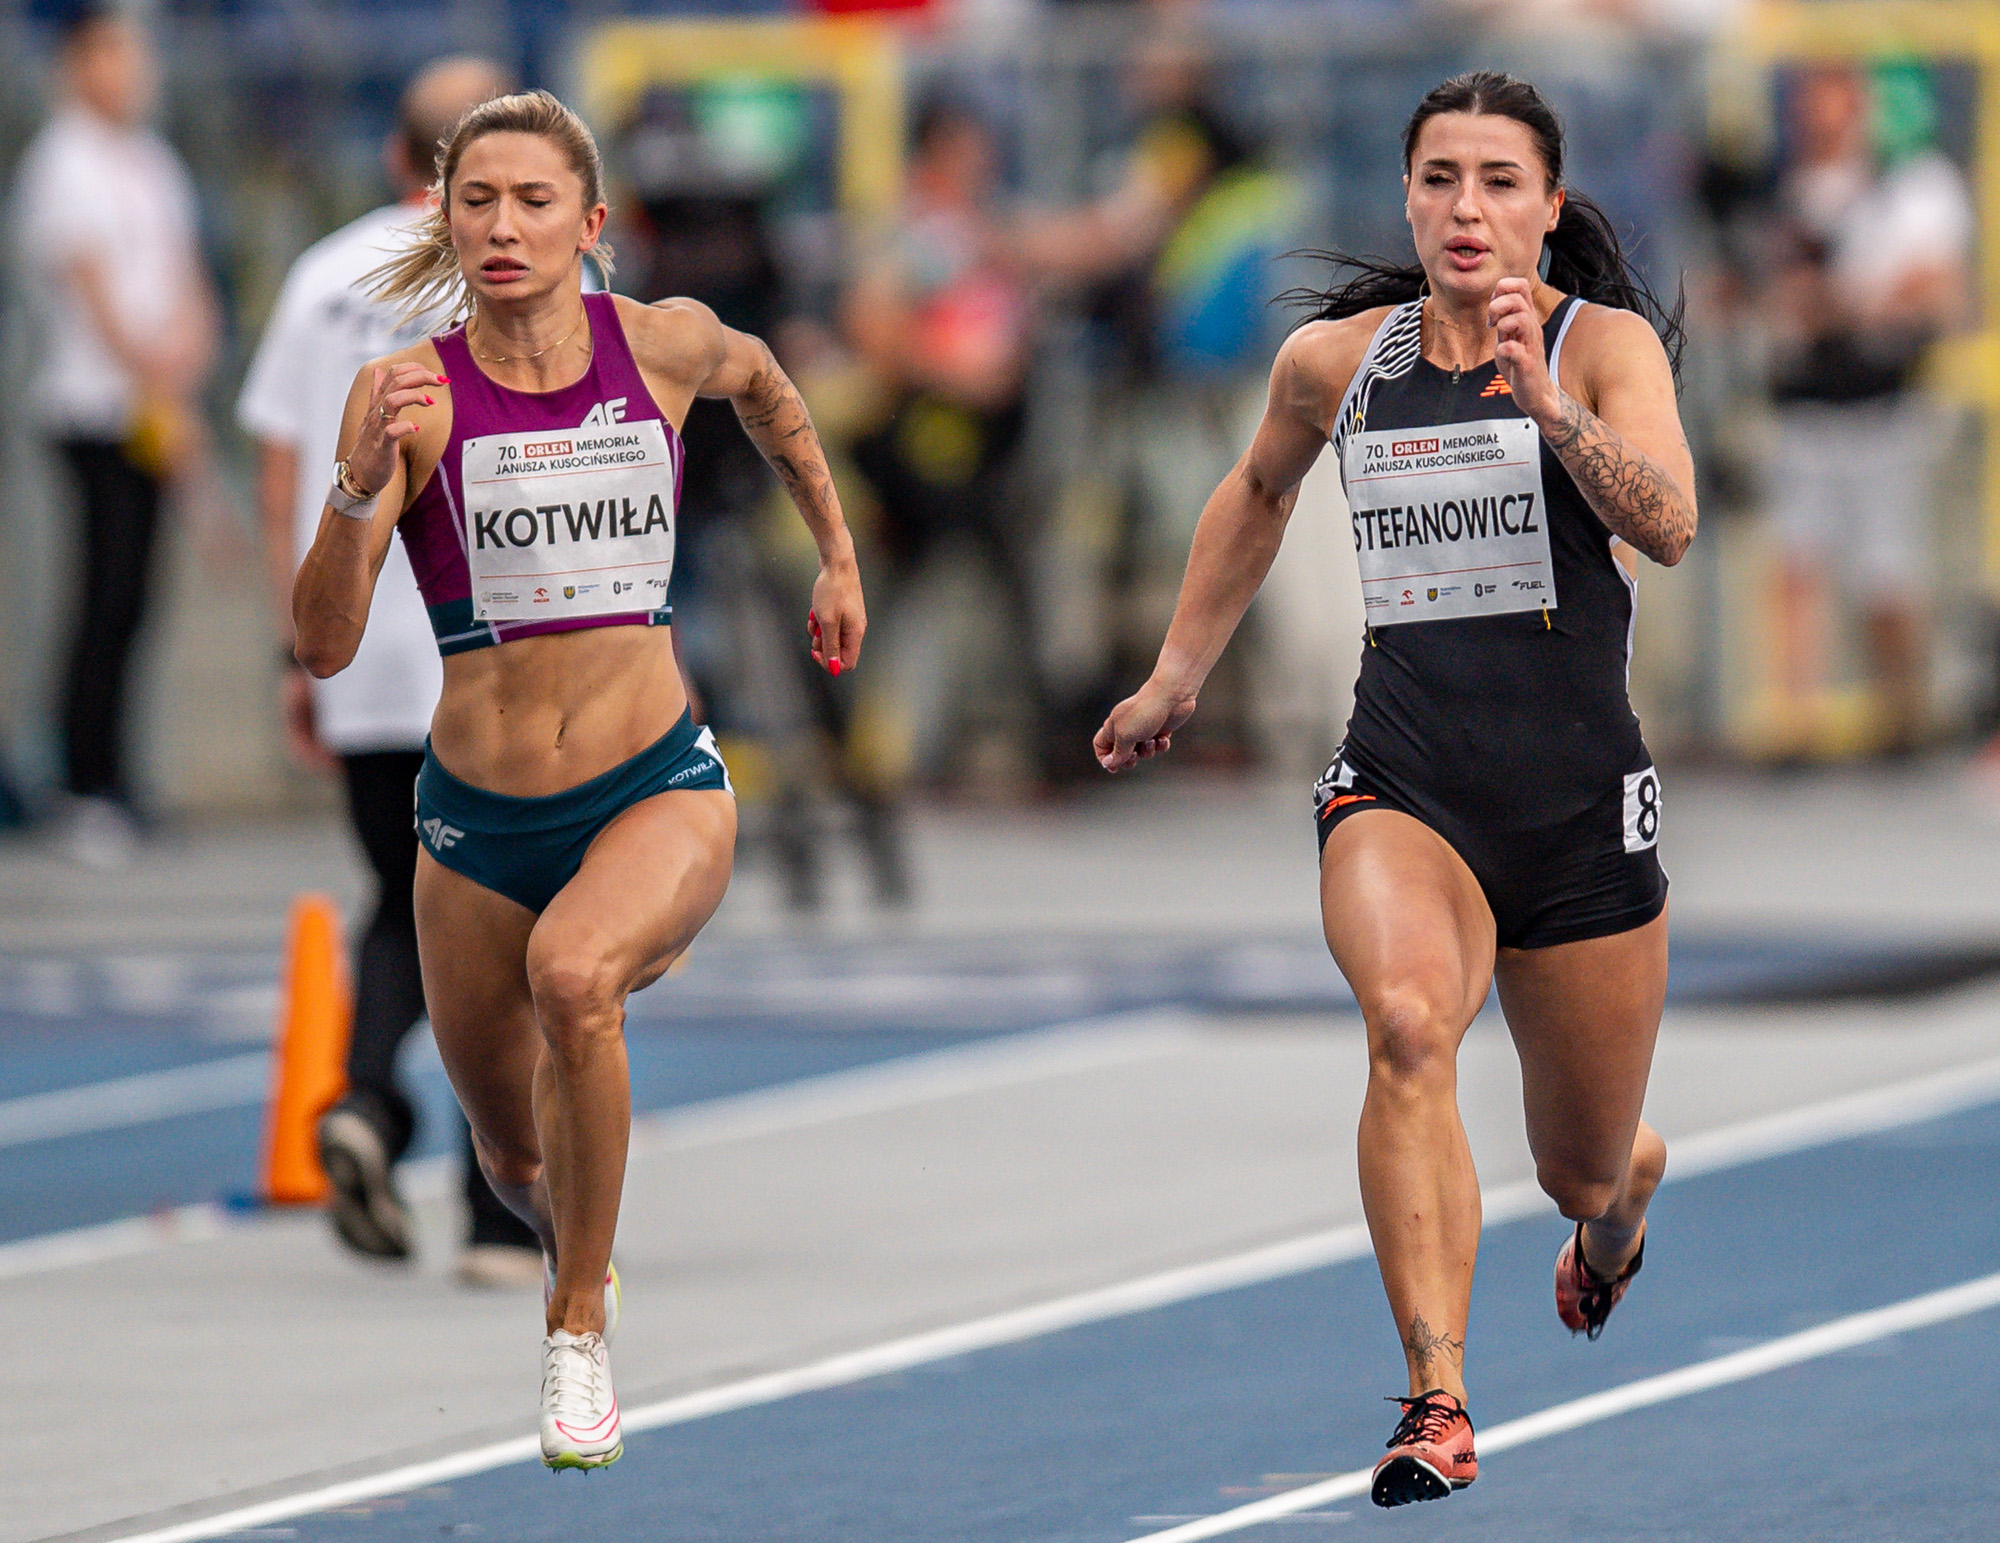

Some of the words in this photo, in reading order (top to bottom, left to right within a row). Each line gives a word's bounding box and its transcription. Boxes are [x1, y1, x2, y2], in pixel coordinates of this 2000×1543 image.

[498, 446, 522, 461] 70.
[526, 442, 571, 457] ORLEN
[576, 435, 641, 452] MEMORIAŁ
[1365, 445, 1389, 460] 70.
[1394, 440, 1438, 455] ORLEN
[1442, 433, 1500, 450] MEMORIAŁ
[495, 462, 547, 475] JANUSZA
[550, 450, 646, 470] KUSOCIŃSKIEGO
[1362, 459, 1413, 474] JANUSZA
[1415, 449, 1505, 468] KUSOCIŃSKIEGO
[474, 493, 670, 550] KOTWIŁA
[1352, 492, 1539, 552] STEFANOWICZ
[1636, 774, 1658, 843] 8
